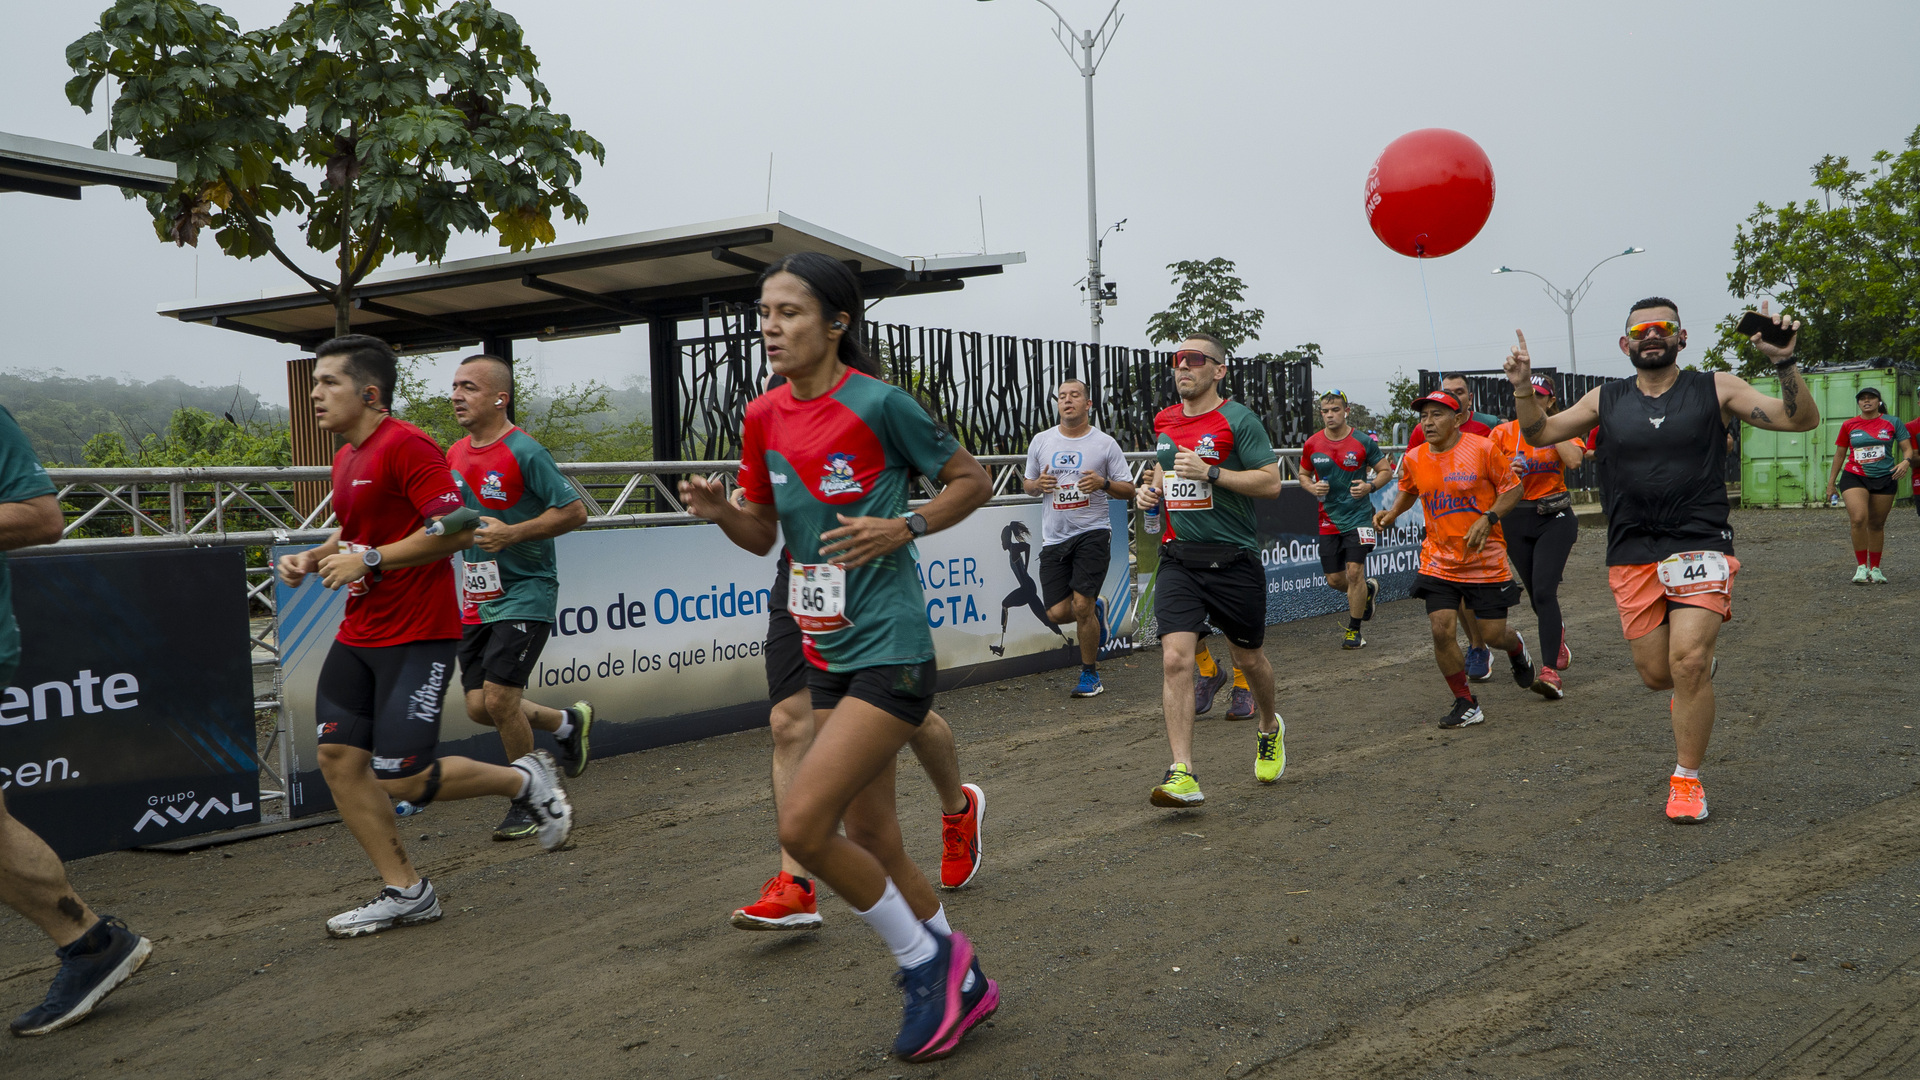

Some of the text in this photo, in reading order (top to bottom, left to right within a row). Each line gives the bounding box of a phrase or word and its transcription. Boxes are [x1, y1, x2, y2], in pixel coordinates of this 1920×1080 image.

[1861, 451, 1878, 459] 362
[1058, 491, 1080, 503] 844
[1171, 482, 1197, 498] 502
[1382, 525, 1422, 548] HACER,
[1271, 541, 1288, 566] de
[1366, 550, 1421, 577] IMPACTA
[1683, 564, 1708, 580] 44
[1268, 578, 1280, 594] de
[1281, 576, 1294, 592] los
[1295, 577, 1311, 593] que
[606, 592, 647, 631] de
[538, 657, 591, 688] lado
[597, 652, 625, 679] de
[631, 649, 662, 674] los
[668, 647, 706, 674] que
[147, 790, 195, 807] Grupo
[133, 792, 253, 833] AVAL
